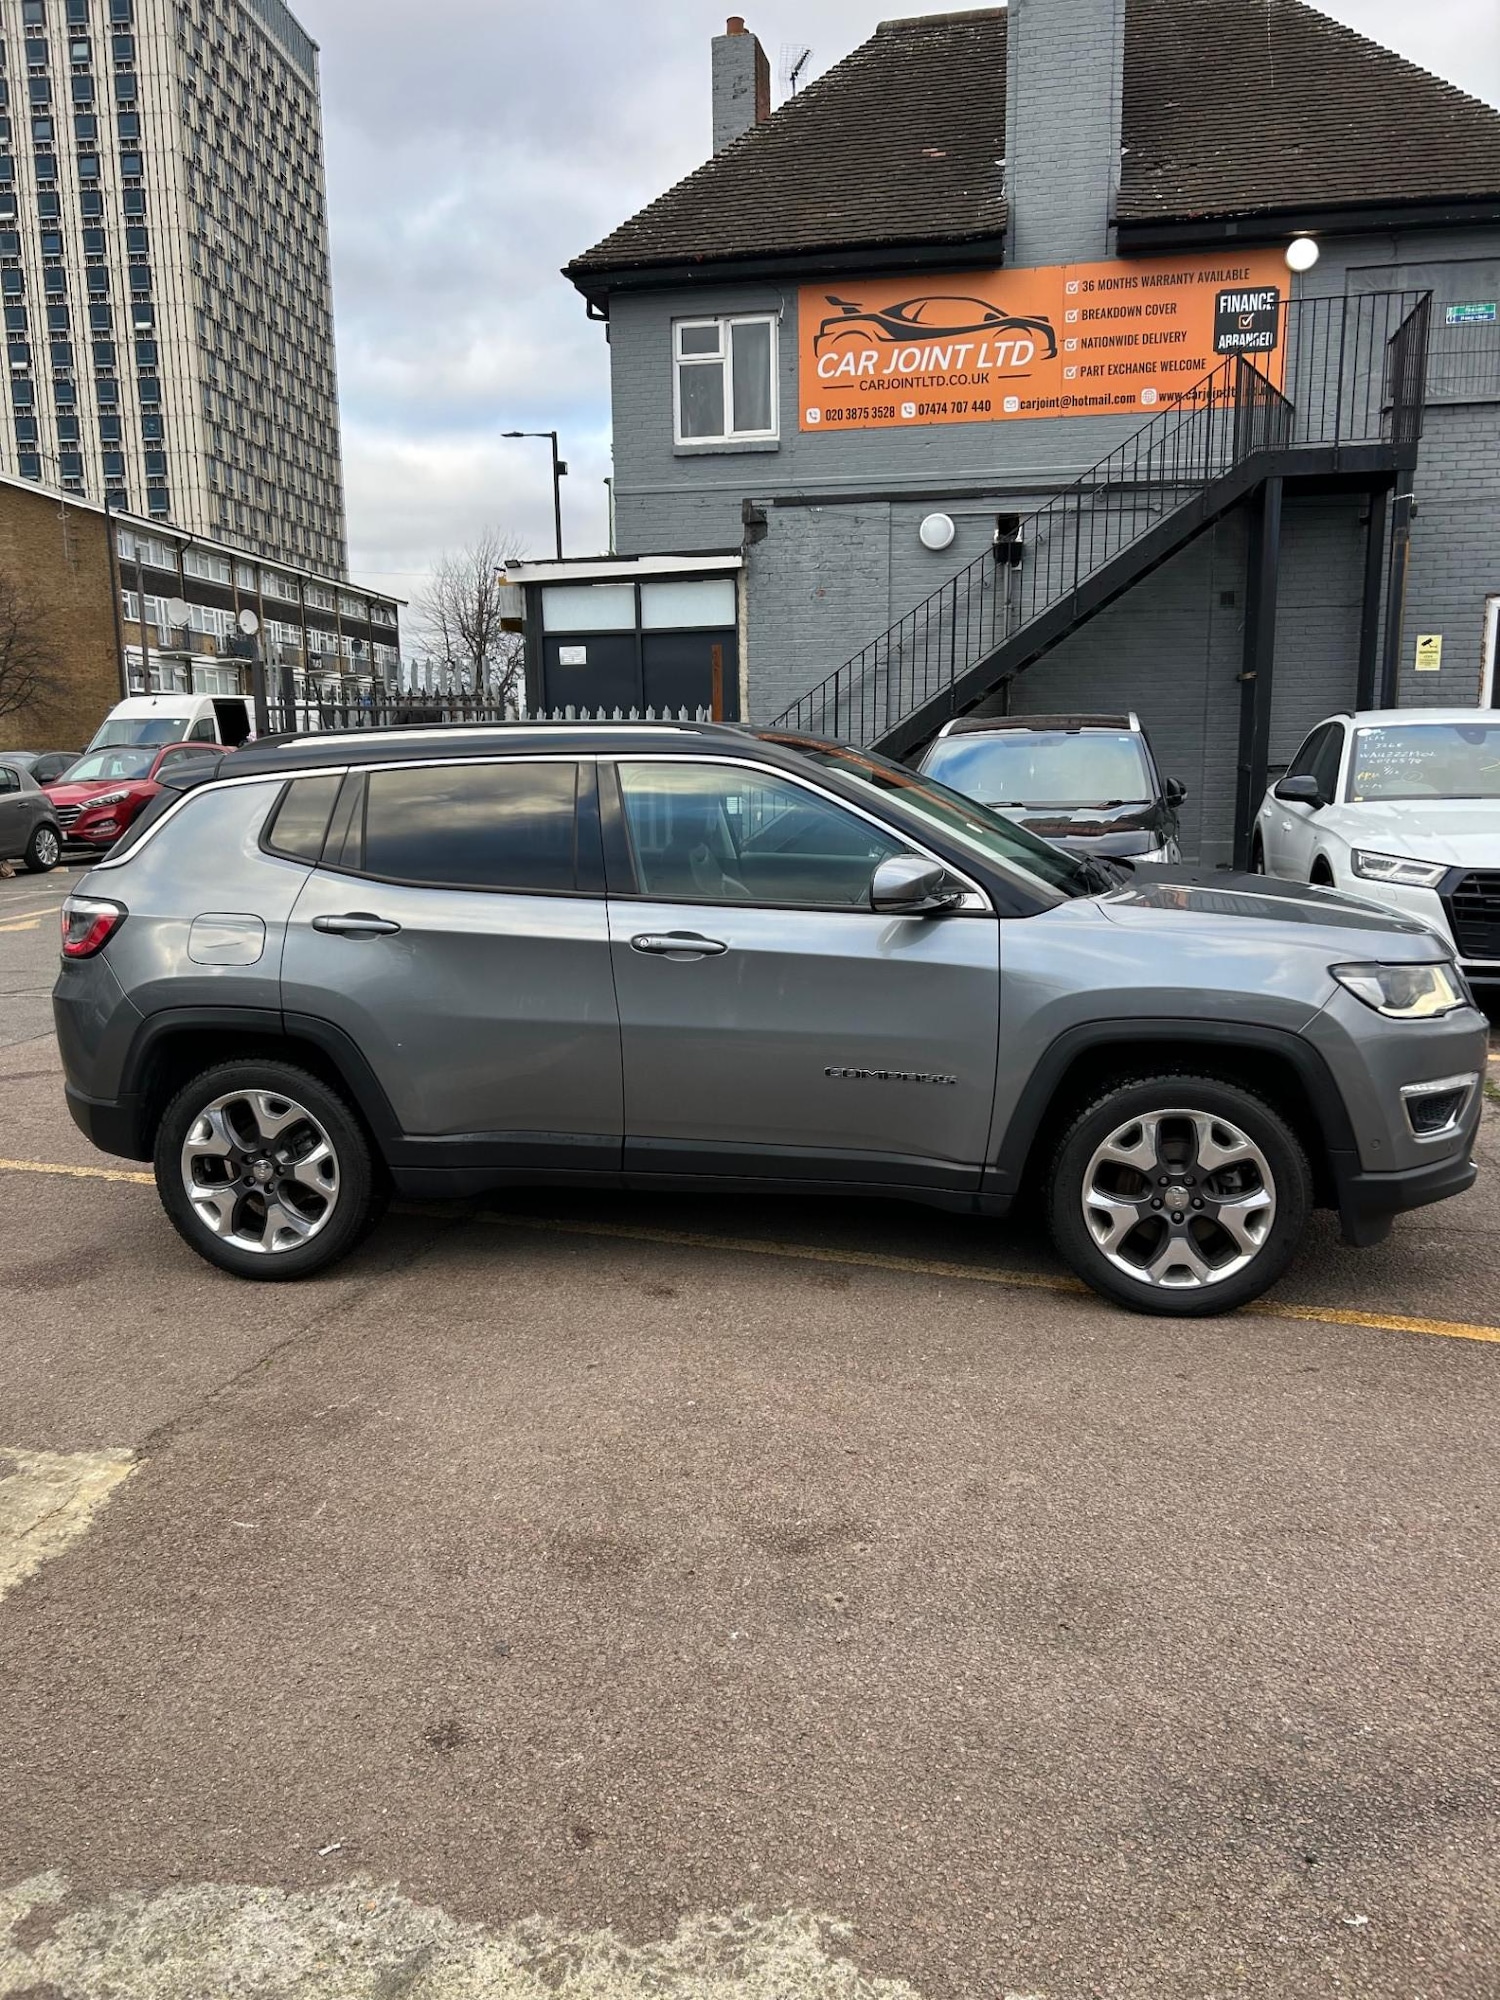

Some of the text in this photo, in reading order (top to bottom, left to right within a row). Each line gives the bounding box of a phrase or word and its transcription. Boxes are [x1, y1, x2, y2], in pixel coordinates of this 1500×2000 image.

[1082, 268, 1250, 292] 36 MONTHS WARRANTY AVAILABLE
[1081, 303, 1177, 321] BREAKDOWN COVER
[1220, 292, 1275, 314] FINANCE
[1081, 331, 1187, 349] NATIONWIDE DELIVERY
[817, 340, 1035, 378] CAR JOINT LTD
[1080, 358, 1207, 377] PART EXCHANGE WELCOME
[860, 373, 989, 391] CARJOINTLTD.CO.UK
[918, 399, 991, 416] 07474 707 440
[1020, 393, 1136, 410] carjoint@hotmail.com
[826, 406, 895, 421] 020 3875 3528
